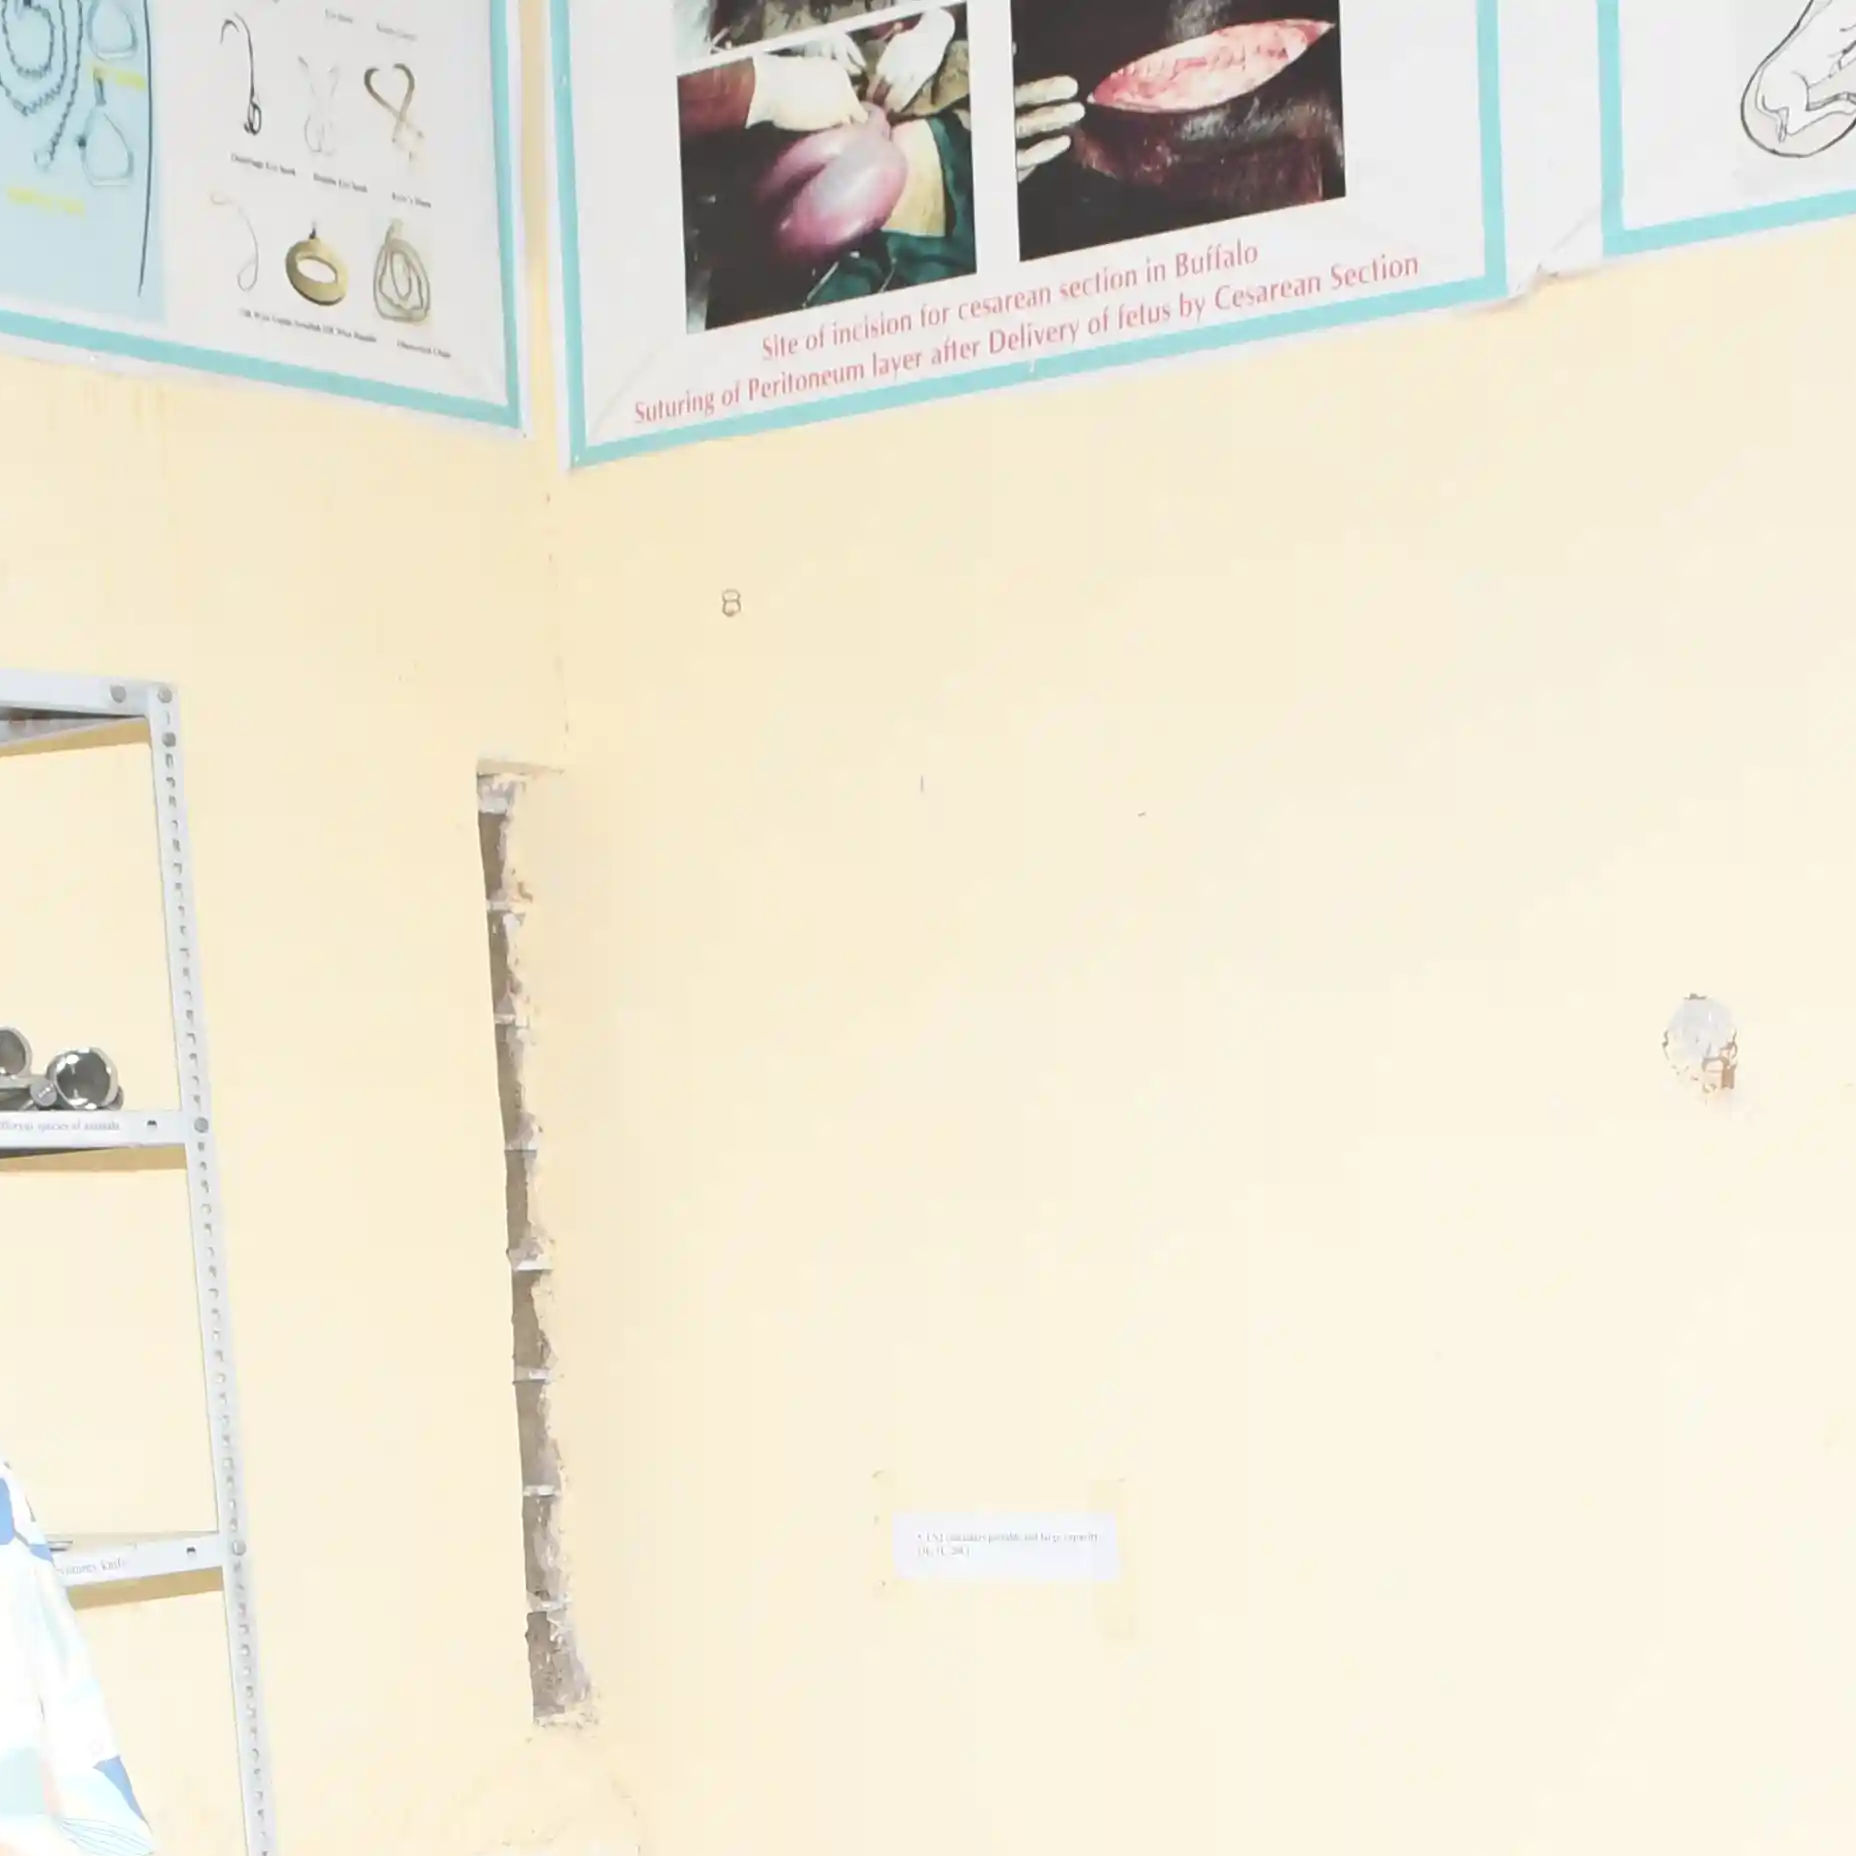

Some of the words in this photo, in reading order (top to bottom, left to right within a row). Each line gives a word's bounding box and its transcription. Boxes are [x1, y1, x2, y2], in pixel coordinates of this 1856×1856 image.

[634, 387, 716, 424] Suturing
[721, 380, 741, 407] of
[748, 361, 865, 401] Peritoneum
[872, 350, 923, 381] layer
[931, 335, 982, 367] after
[989, 318, 1081, 355] Delivery
[1088, 306, 1109, 335] of
[1118, 300, 1172, 330] fetus
[1179, 292, 1206, 322] by
[1214, 275, 1322, 311] Cesarean
[1330, 253, 1420, 290] Section
[761, 334, 799, 360] Site
[805, 329, 826, 351] of
[832, 311, 913, 344] incision
[921, 303, 949, 328] for
[958, 285, 1052, 321] cesarean
[1059, 266, 1138, 300] section
[1145, 257, 1167, 284] in
[1175, 238, 1259, 279] Buffalo
